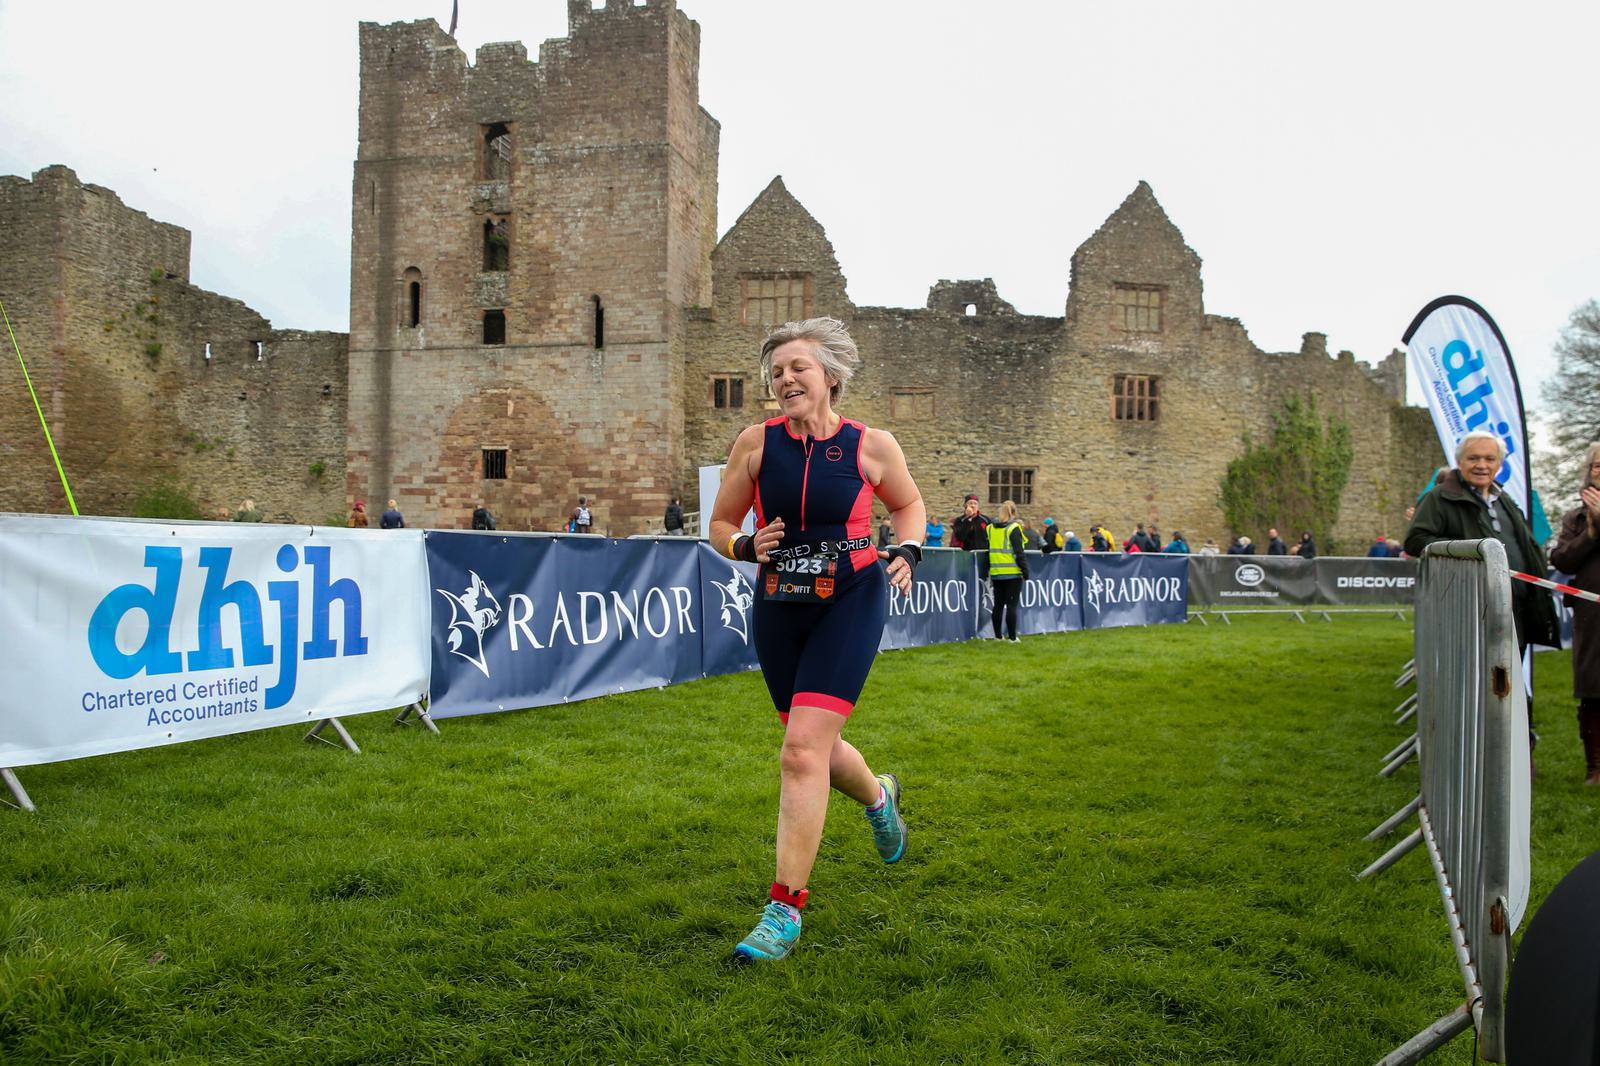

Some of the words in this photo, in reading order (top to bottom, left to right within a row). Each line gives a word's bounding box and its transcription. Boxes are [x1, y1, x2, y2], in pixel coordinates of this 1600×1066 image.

[779, 583, 811, 594] FLOWFIT
[889, 579, 969, 616] RADNOR
[1104, 576, 1182, 603] RADNOR
[88, 543, 369, 710] dhjh
[508, 586, 696, 651] RADNOR
[82, 685, 177, 712] Chartered
[183, 676, 258, 702] Certified
[147, 697, 258, 726] Accountants
